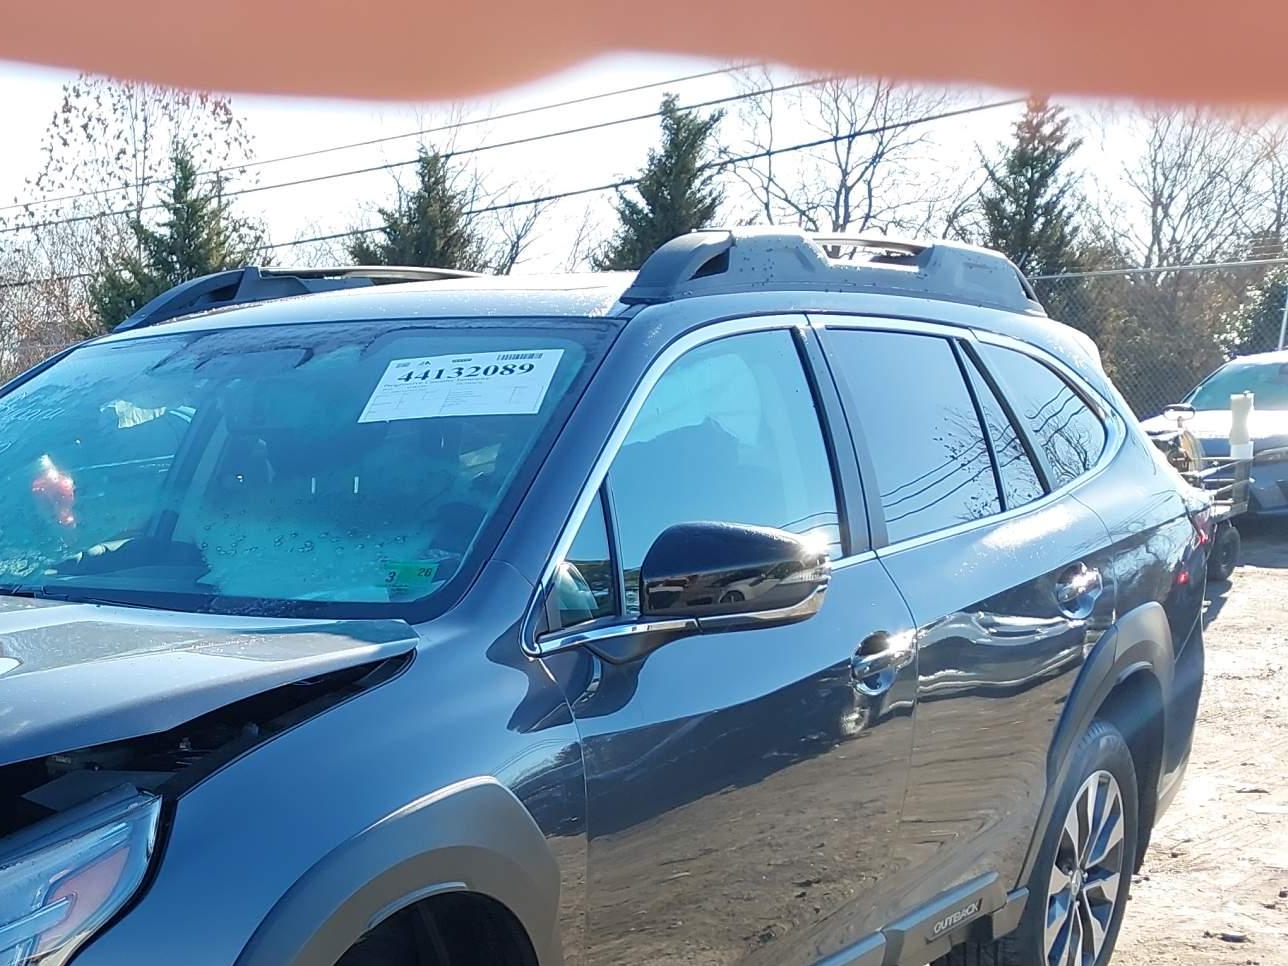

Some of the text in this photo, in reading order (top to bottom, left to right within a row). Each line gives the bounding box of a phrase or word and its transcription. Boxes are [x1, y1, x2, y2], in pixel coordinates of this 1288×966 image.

[397, 363, 535, 382] 44132089
[385, 572, 396, 583] 3
[418, 568, 432, 577] 26
[933, 901, 979, 934] OUTBACK
